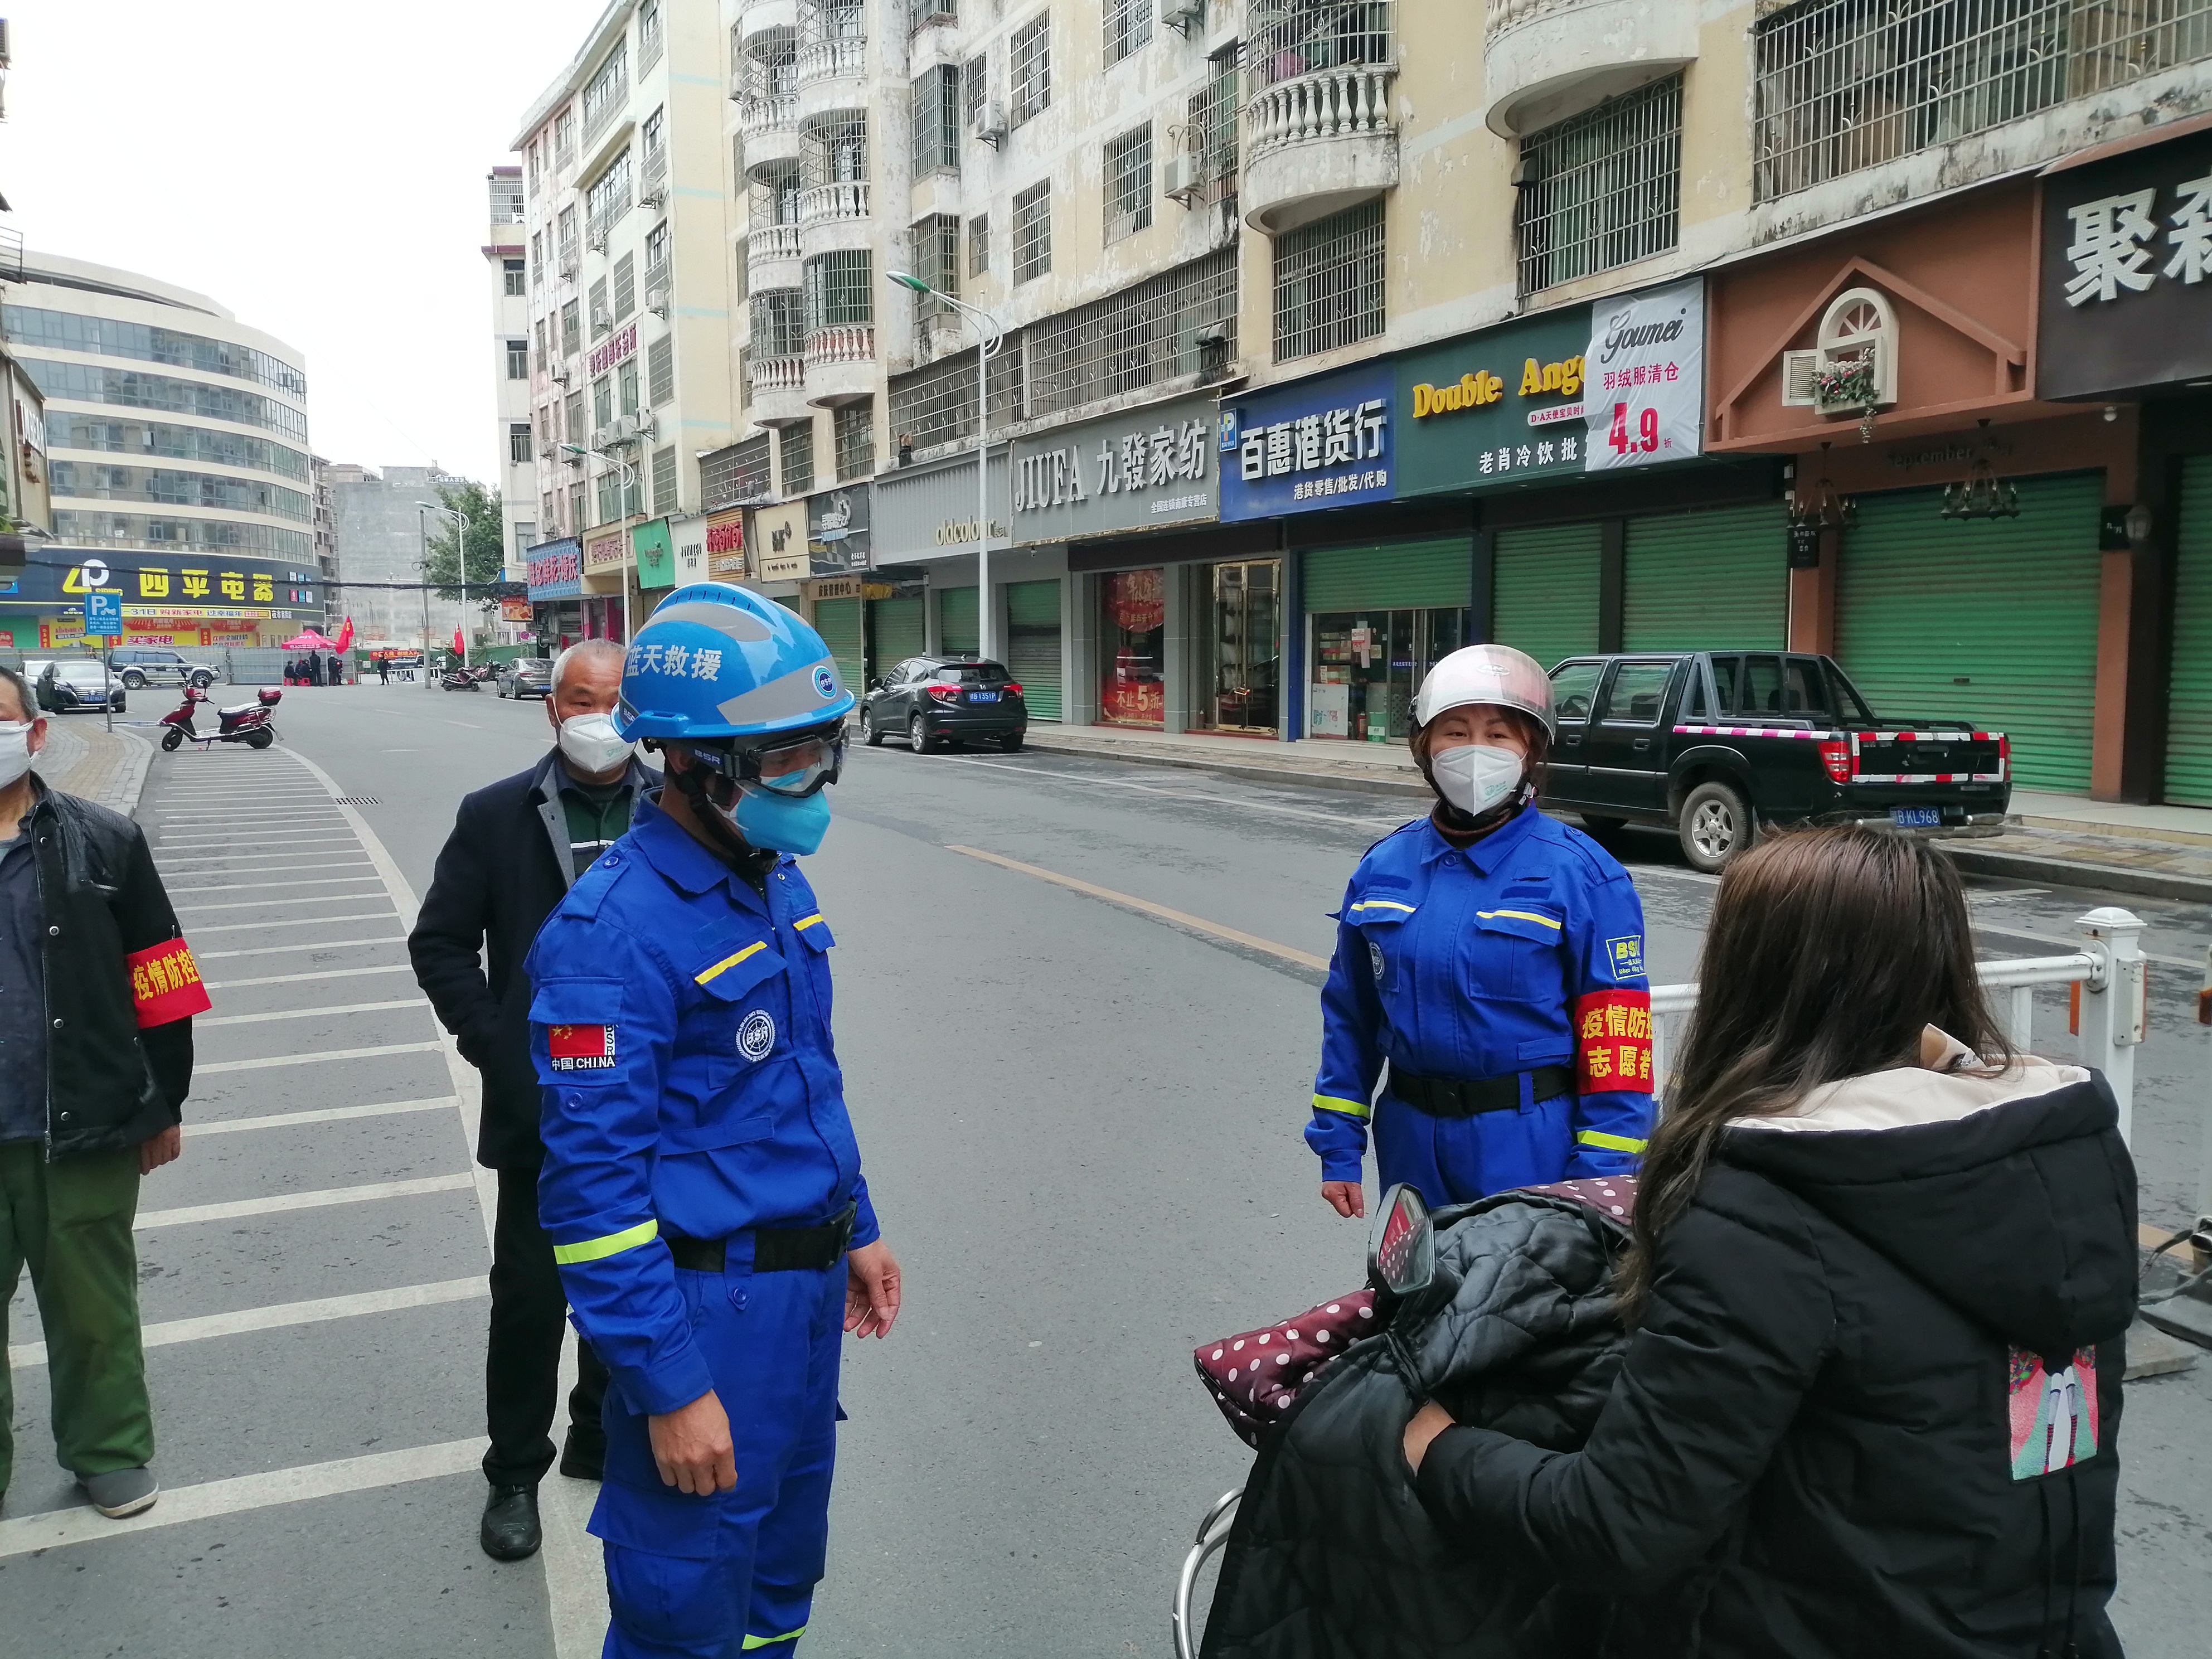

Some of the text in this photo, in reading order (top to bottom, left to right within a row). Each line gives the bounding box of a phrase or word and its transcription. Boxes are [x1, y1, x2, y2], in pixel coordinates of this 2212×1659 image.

[1600, 308, 1686, 363] Goumei
[1603, 361, 1680, 390] 羽绒服清仓
[1413, 370, 1503, 418] Double
[1240, 400, 1388, 481] 百惠港货行
[1478, 436, 1588, 474] 老肖冷饮批
[1015, 445, 1089, 512] JIUFA
[1294, 469, 1387, 501] 港货零售/批发/代购
[1151, 493, 1207, 514] 全国连锁南康专营店
[936, 516, 995, 547] oldcolor
[818, 581, 851, 597] 皮肤管理中心
[159, 608, 203, 617] 购新家电
[127, 634, 174, 646] 买家电
[625, 644, 723, 682] 蓝天救援
[821, 677, 832, 687] BSR
[694, 749, 720, 764] BSR
[1890, 809, 1938, 824] B·KL968
[605, 1024, 614, 1056] BSR
[746, 1025, 768, 1045] BSR
[551, 1056, 616, 1071] 中国 CHINA
[1587, 1045, 1652, 1080] 志愿者
